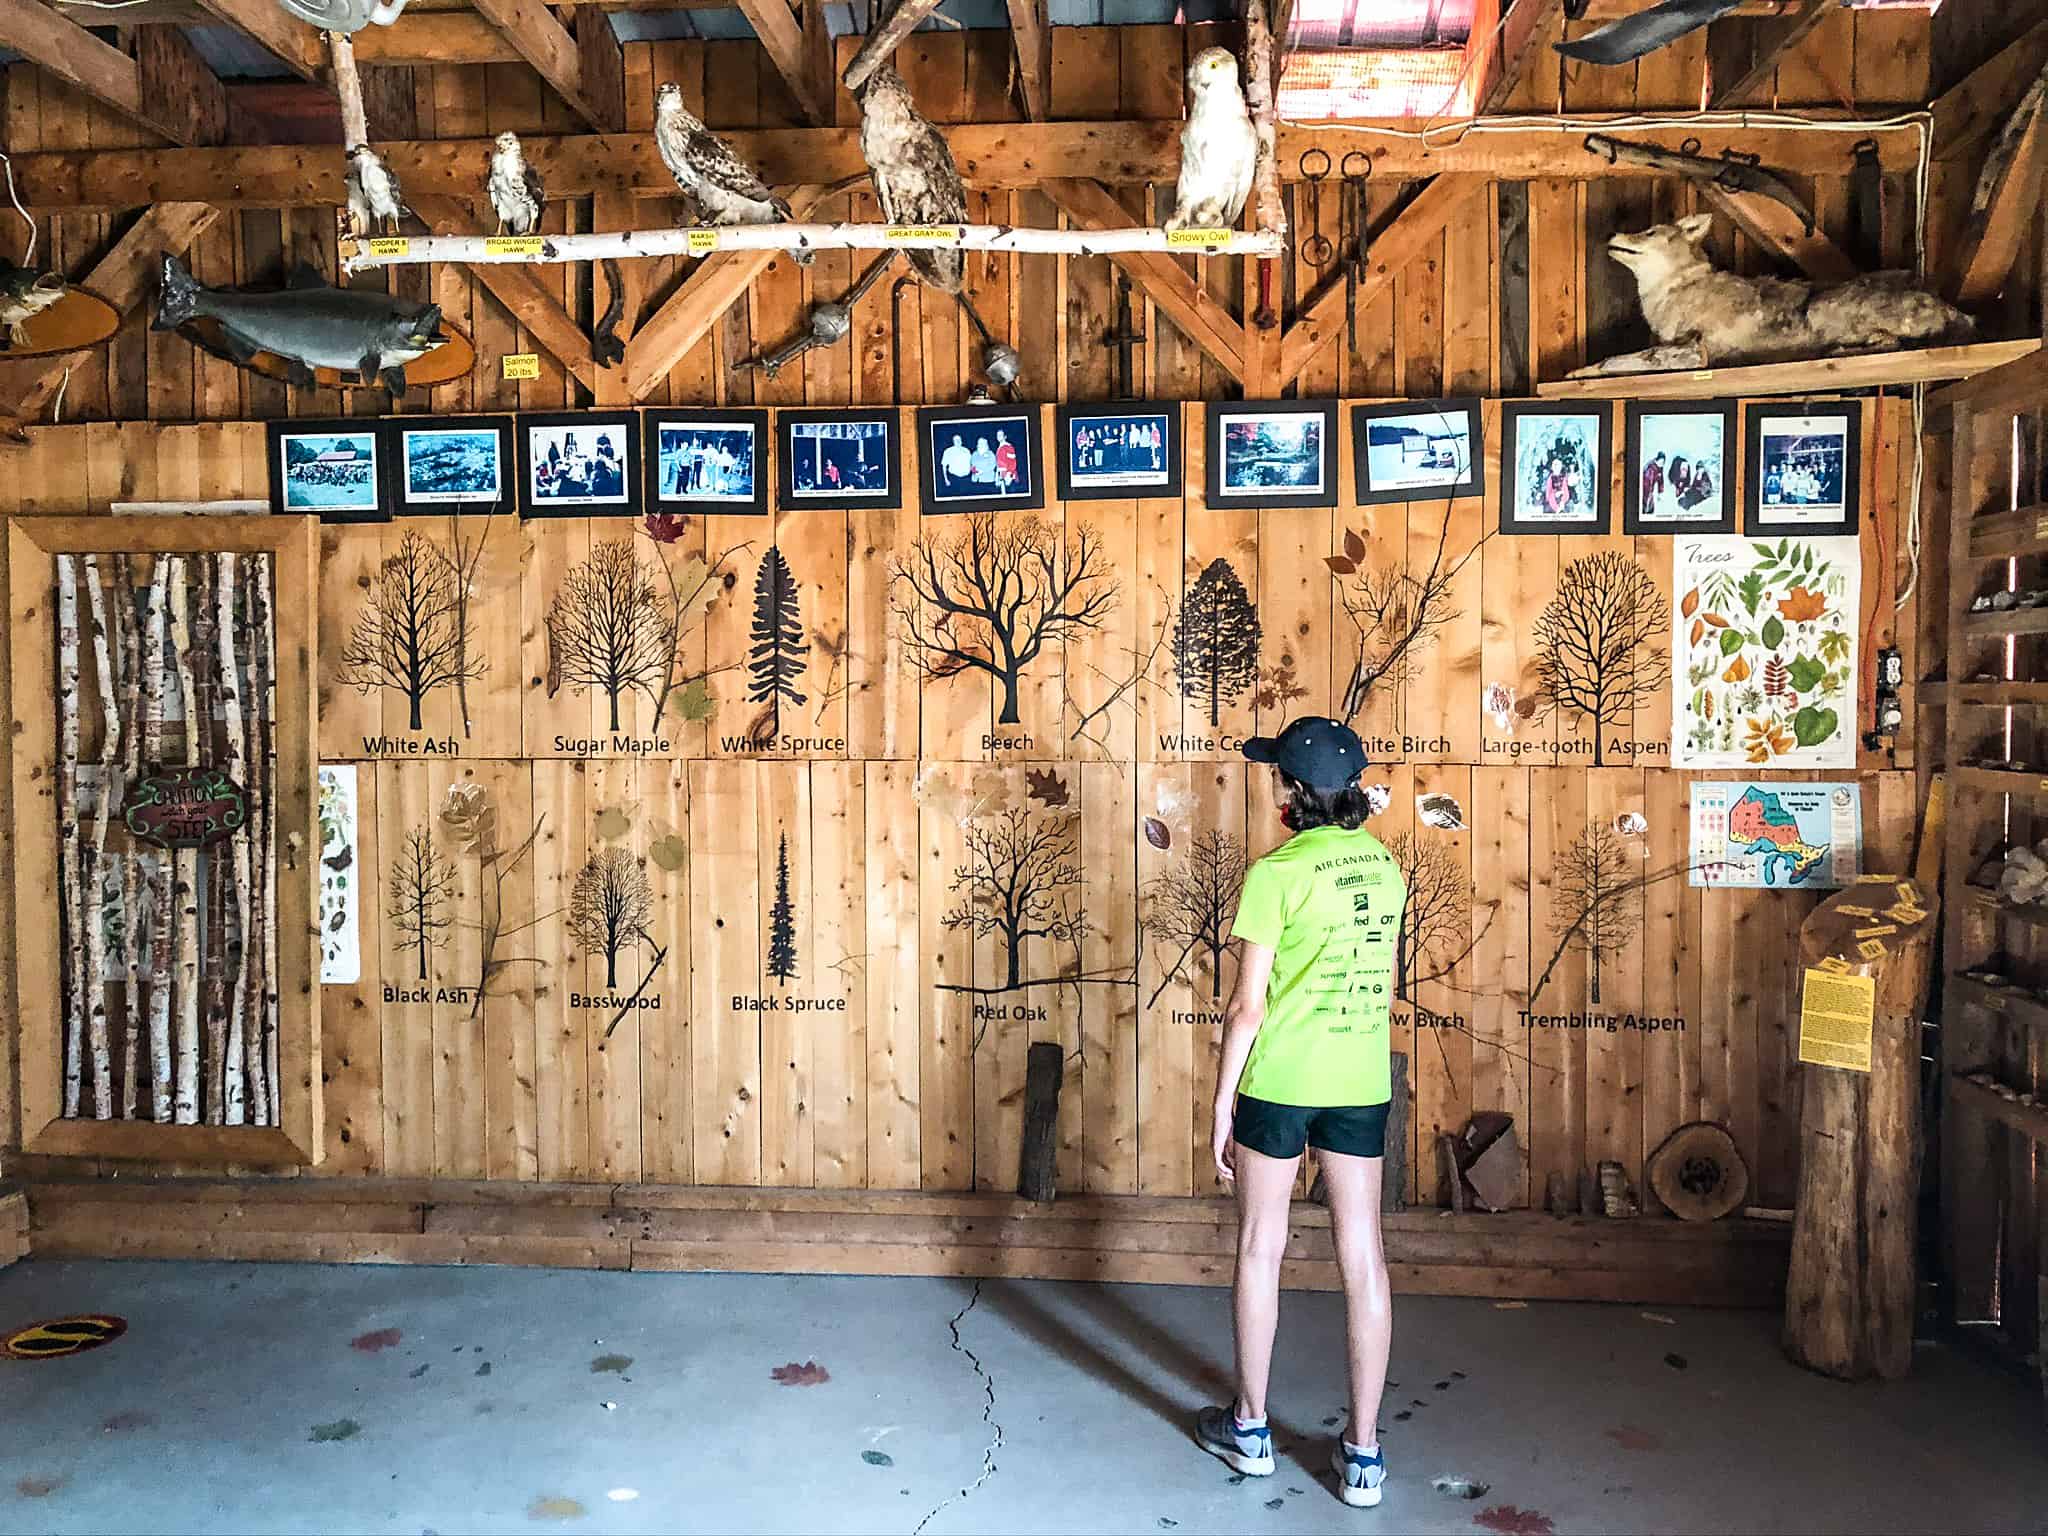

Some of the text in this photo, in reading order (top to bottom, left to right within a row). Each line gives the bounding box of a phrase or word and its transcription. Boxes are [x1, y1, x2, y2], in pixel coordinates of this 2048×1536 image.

[1171, 231, 1229, 243] Snowy Owl
[505, 358, 536, 366] Salmon
[507, 368, 518, 376] 20
[1684, 543, 1735, 563] Trees
[363, 736, 459, 755] White Ash
[554, 735, 670, 757] Sugar Maple
[722, 734, 845, 756] White Spruce
[982, 735, 1033, 750] Beech
[1160, 735, 1214, 751] White
[1360, 736, 1450, 753] hite Birch
[1483, 736, 1668, 758] Large-tooth Aspen
[1314, 854, 1380, 873] AIR CANADA
[384, 987, 468, 1003] Black Ash
[570, 993, 661, 1009] Basswood
[732, 995, 846, 1014] Black Spruce
[974, 1004, 1047, 1021] Red Oak
[1172, 1010, 1225, 1024] Ironw
[1417, 1012, 1465, 1028] Birch
[1518, 1010, 1686, 1032] Trembling Aspen
